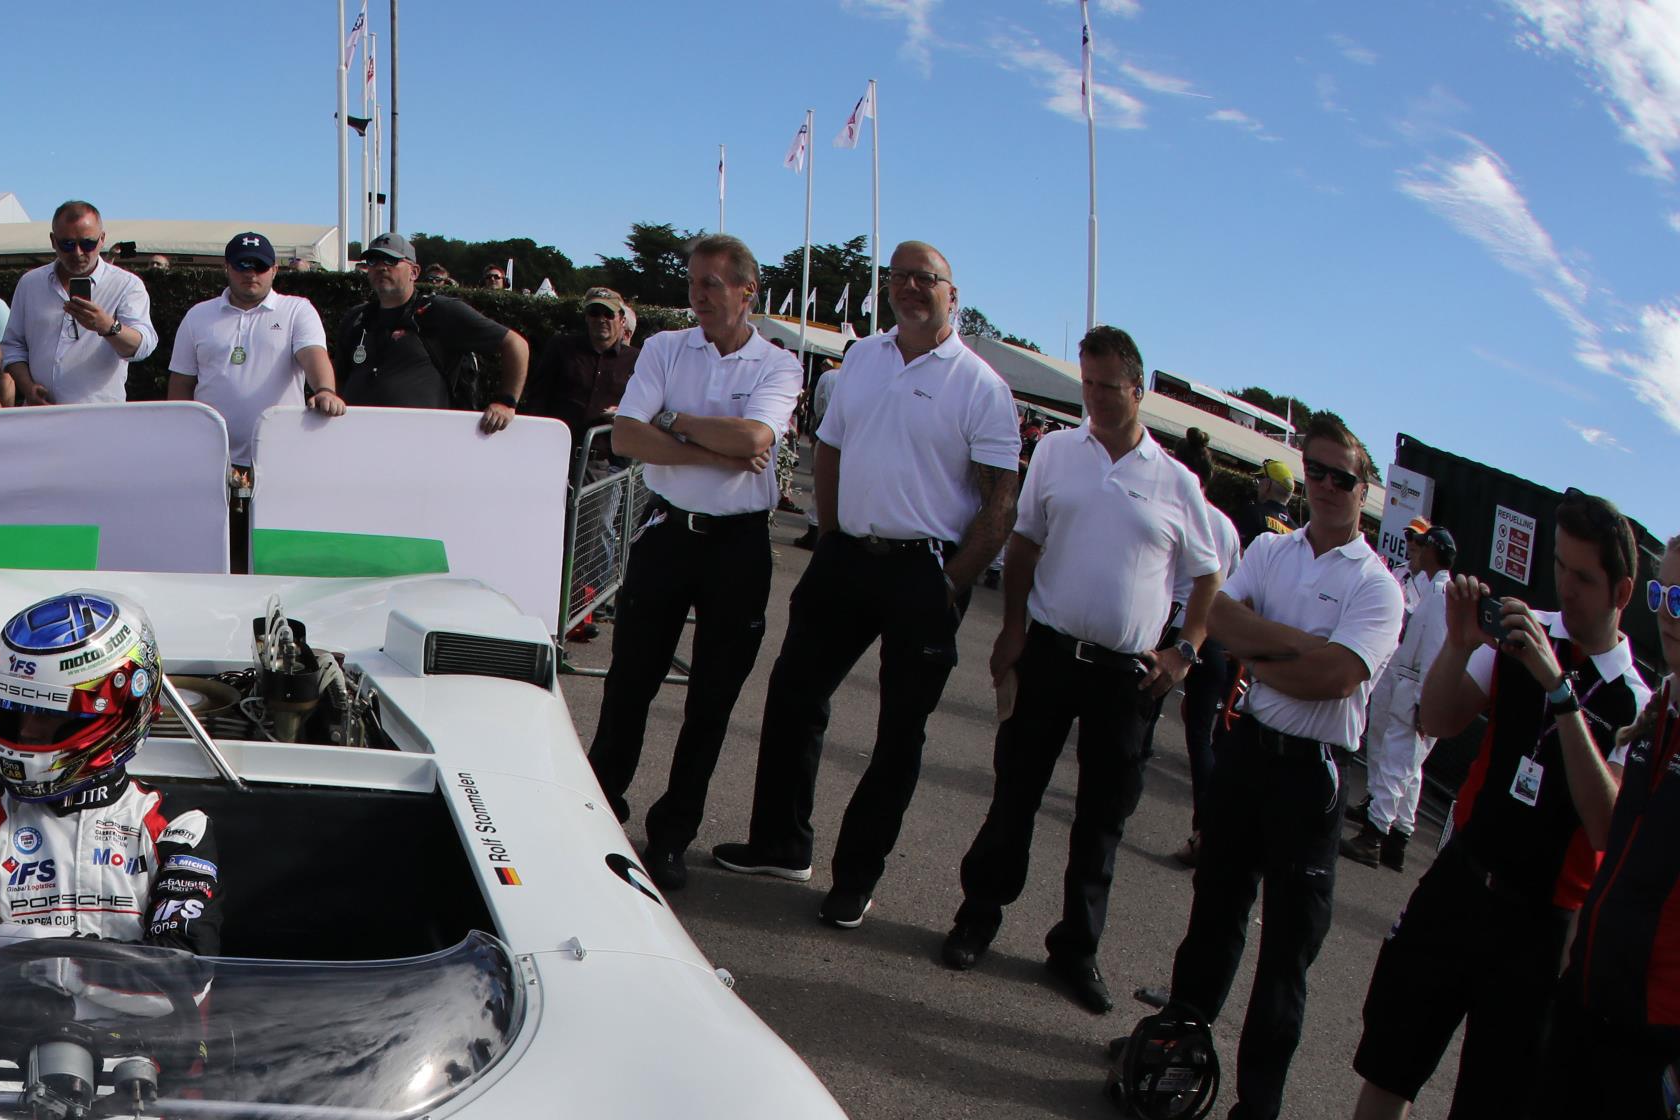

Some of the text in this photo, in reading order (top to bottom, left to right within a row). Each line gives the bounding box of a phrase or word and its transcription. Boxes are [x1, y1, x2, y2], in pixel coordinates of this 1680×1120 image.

[1497, 509, 1534, 531] REFUELLING
[75, 785, 108, 806] JTR
[458, 773, 511, 862] Rolf Stommelen
[8, 858, 56, 886] IFS
[92, 848, 139, 875] Moil
[11, 894, 134, 910] PORSCHE
[54, 915, 77, 926] CUP
